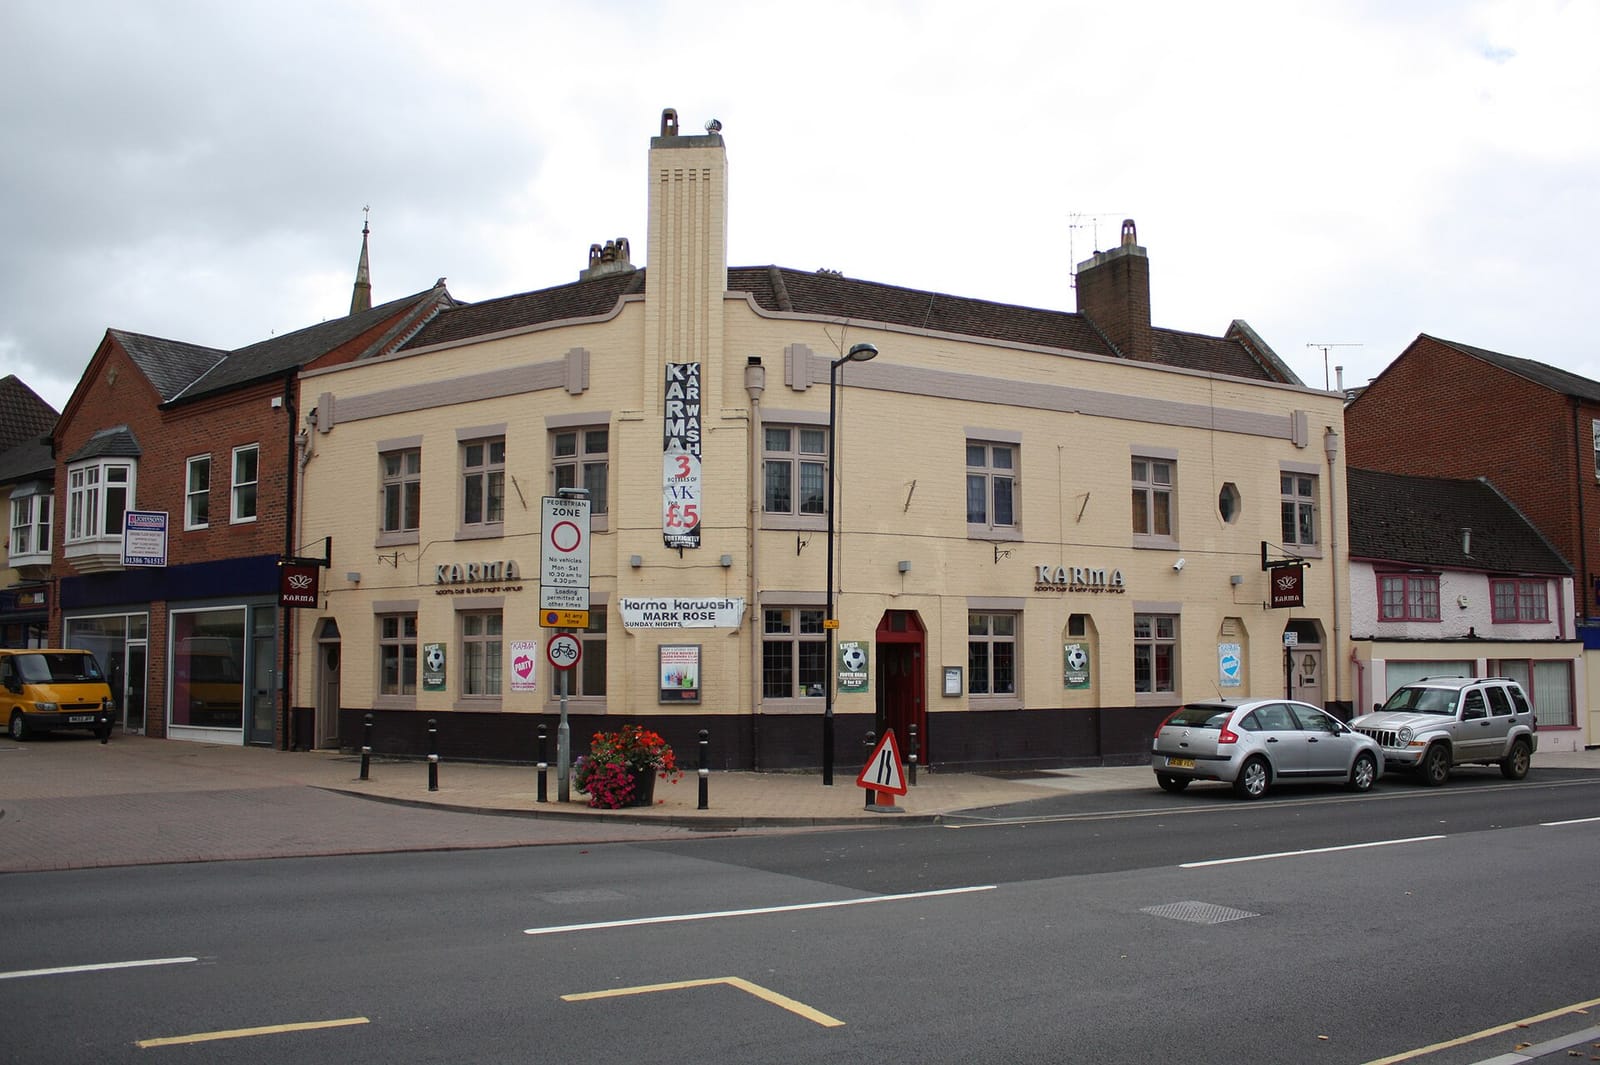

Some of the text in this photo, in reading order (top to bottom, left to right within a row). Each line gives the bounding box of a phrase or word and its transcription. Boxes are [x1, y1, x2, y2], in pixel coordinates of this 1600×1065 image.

[665, 363, 685, 453] KARMA
[674, 455, 691, 479] 3
[671, 486, 694, 500] VK
[546, 499, 587, 508] PEDESTRIAN
[552, 508, 581, 517] ZONE
[665, 504, 699, 529] £5
[434, 560, 521, 585] KARMA
[1034, 565, 1126, 587] KARMA
[283, 594, 314, 602] KARMA
[1274, 594, 1300, 602] KARMA
[624, 599, 734, 610] karma karwash
[643, 611, 716, 620] MARK ROSE
